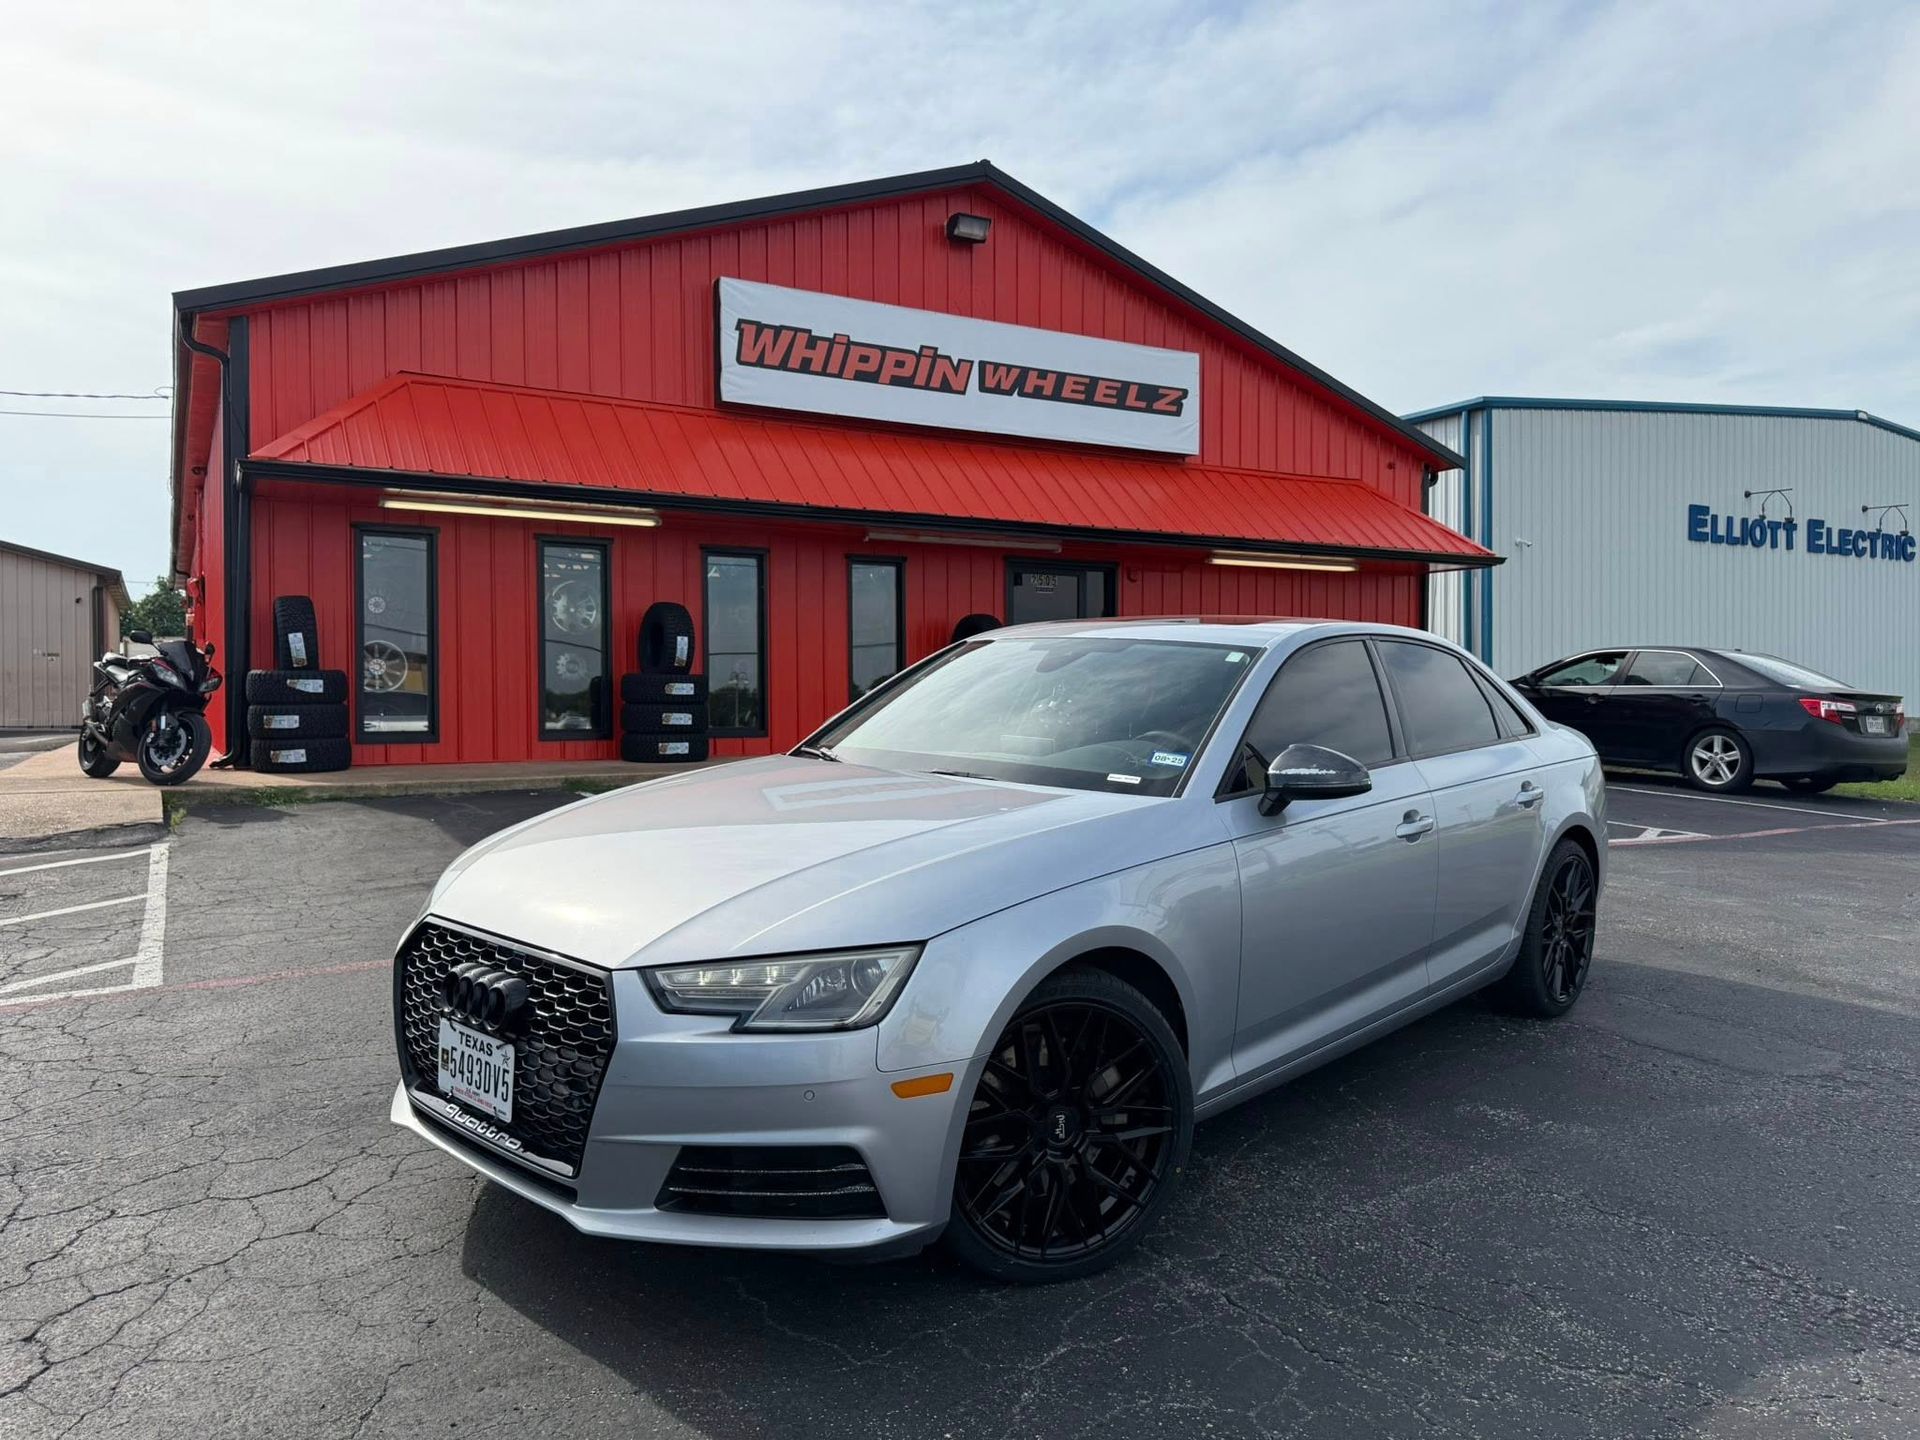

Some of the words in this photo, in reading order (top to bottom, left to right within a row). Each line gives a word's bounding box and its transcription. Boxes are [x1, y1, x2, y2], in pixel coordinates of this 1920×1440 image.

[979, 360, 1188, 417] WHEELZ
[460, 1032, 493, 1057] TEXAS
[450, 1047, 511, 1103] 5493DV5
[445, 1103, 522, 1150] quattro
